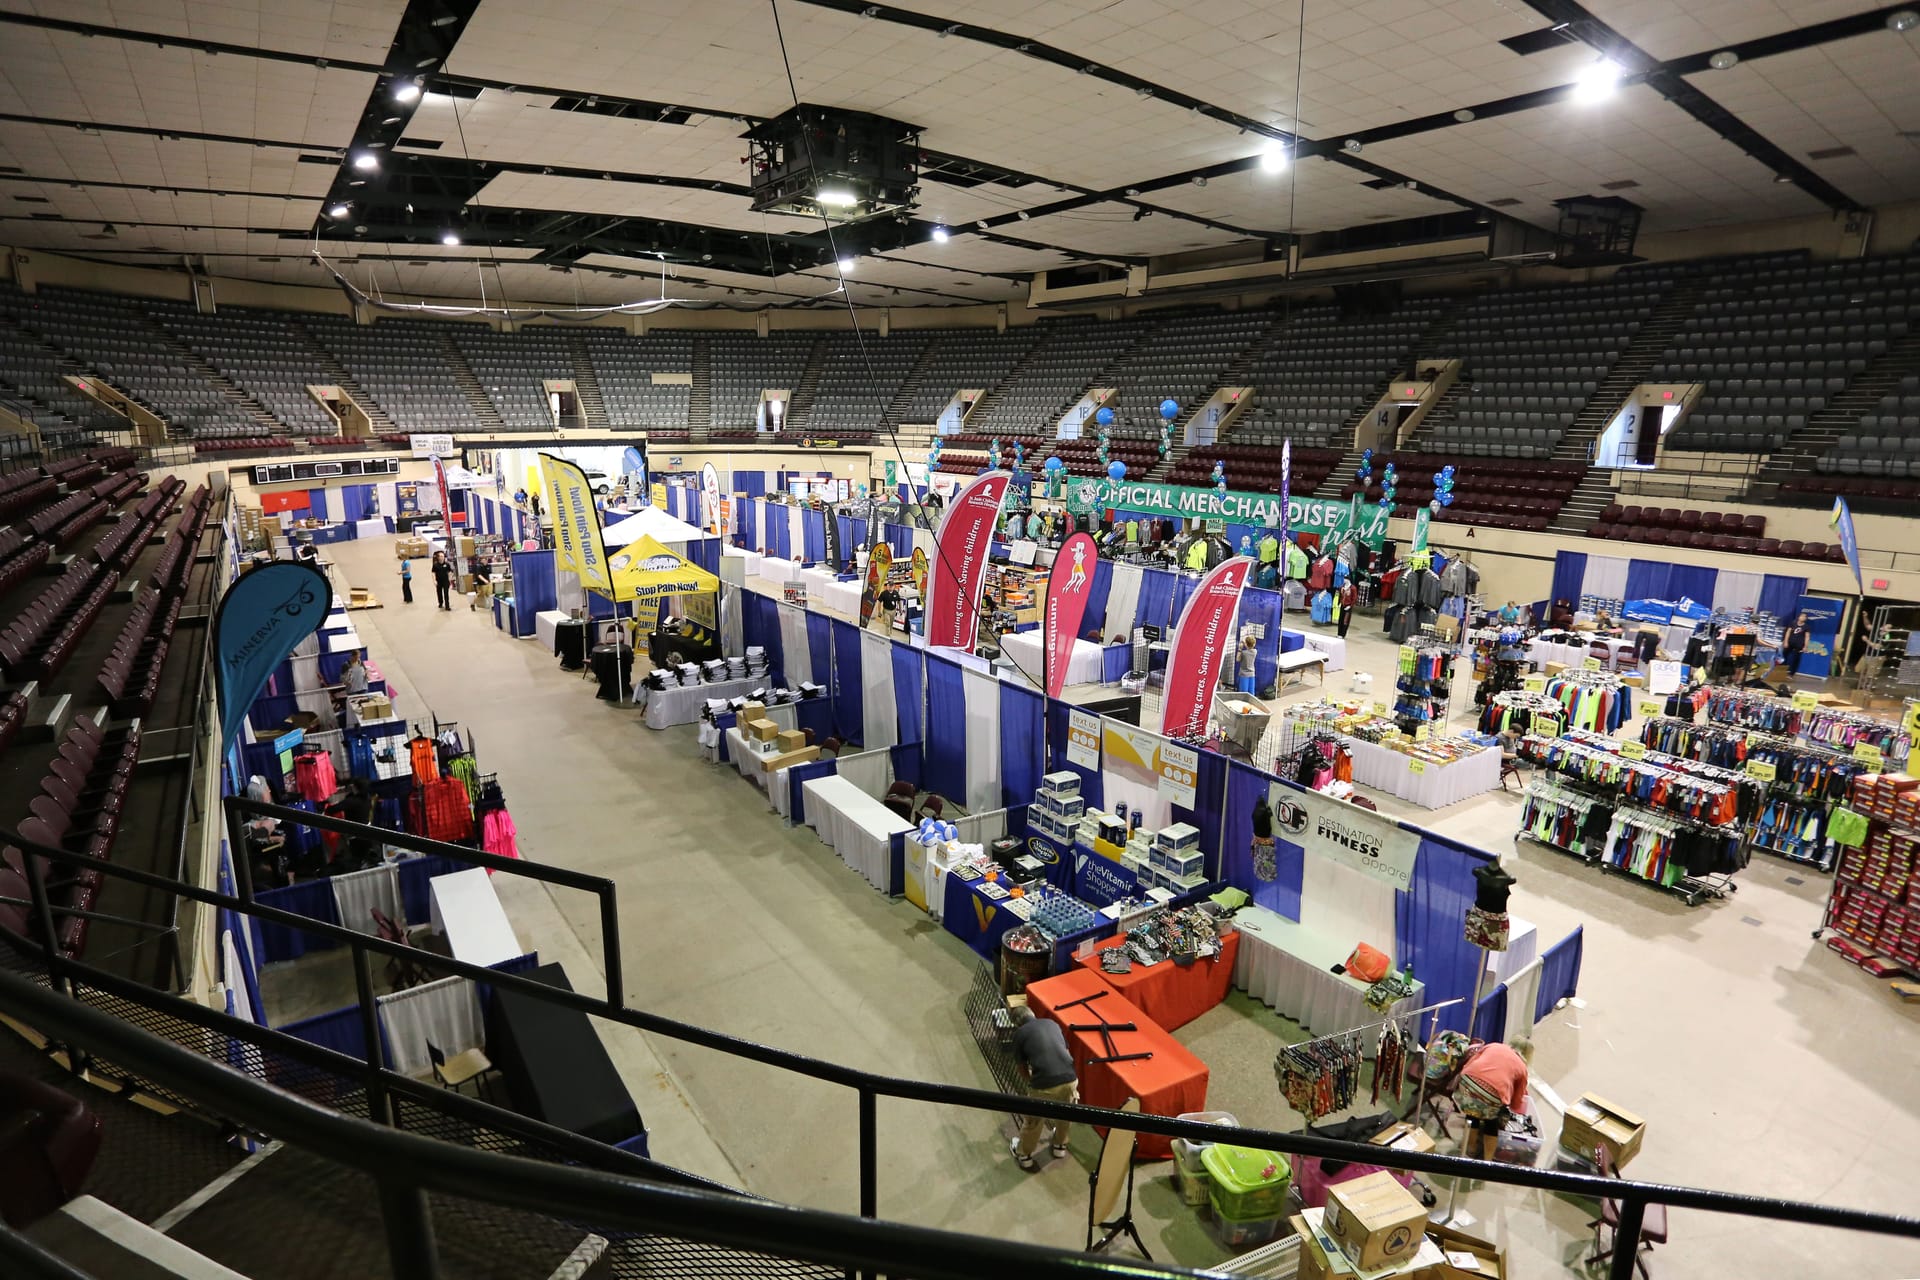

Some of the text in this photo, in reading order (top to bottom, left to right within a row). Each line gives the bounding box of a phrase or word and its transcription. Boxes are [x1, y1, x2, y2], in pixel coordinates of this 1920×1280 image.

[340, 404, 351, 416] 27
[1377, 409, 1389, 428] 14
[1627, 414, 1636, 435] 2
[1096, 484, 1173, 510] OFFICIAL
[1178, 490, 1338, 528] MERCHANDISE
[1466, 527, 1476, 539] A
[635, 581, 699, 597] Stop Pain Now!
[953, 517, 983, 645] Finding cures. Saving children.
[640, 597, 658, 607] FREE
[1206, 605, 1223, 645] children.
[229, 616, 281, 669] MINERVA
[1198, 643, 1215, 676] Saving
[1195, 678, 1206, 704] cures.
[1072, 714, 1087, 726] text
[1088, 720, 1097, 730] us
[1164, 747, 1193, 765] text us
[1317, 825, 1380, 858] FITNESS
[1318, 815, 1384, 848] DESTINATION
[1361, 856, 1410, 881] apparel
[1086, 870, 1117, 895] Shoppe
